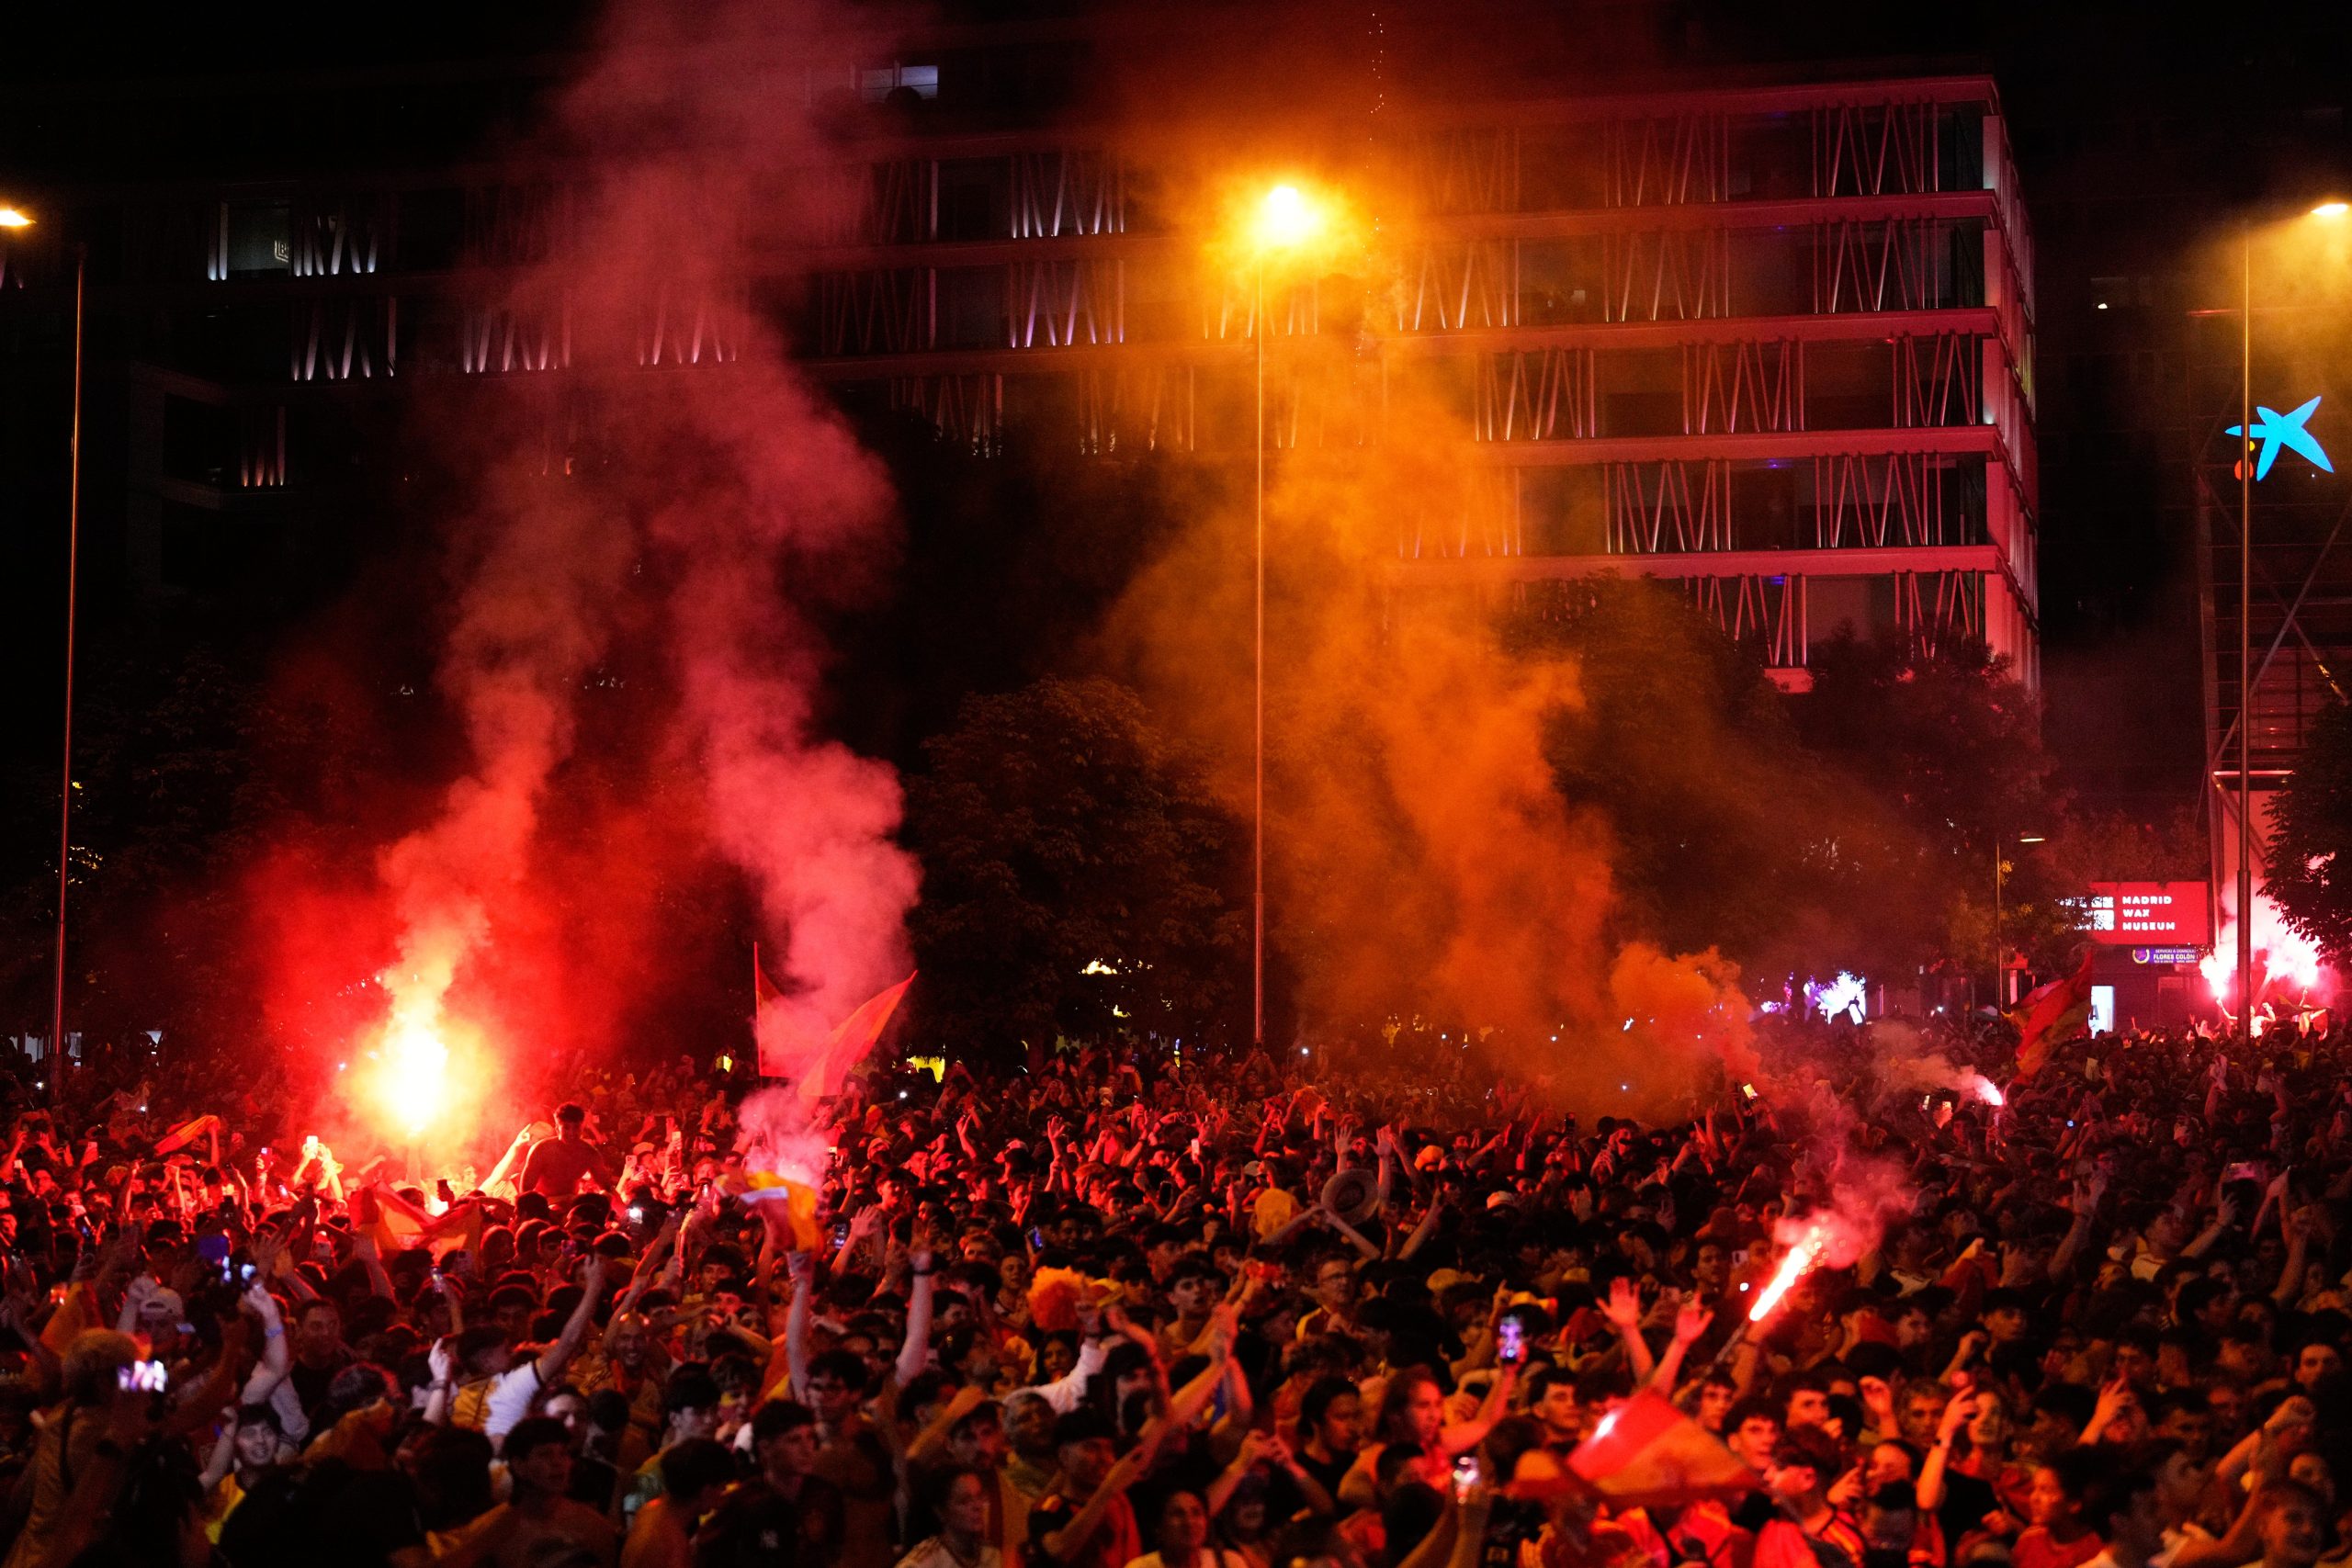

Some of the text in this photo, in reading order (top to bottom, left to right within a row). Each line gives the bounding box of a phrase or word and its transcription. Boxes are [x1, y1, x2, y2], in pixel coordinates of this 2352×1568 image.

[2122, 896, 2172, 904] MADRID
[2123, 908, 2150, 917] WAX
[2122, 921, 2176, 931] MUSEUM
